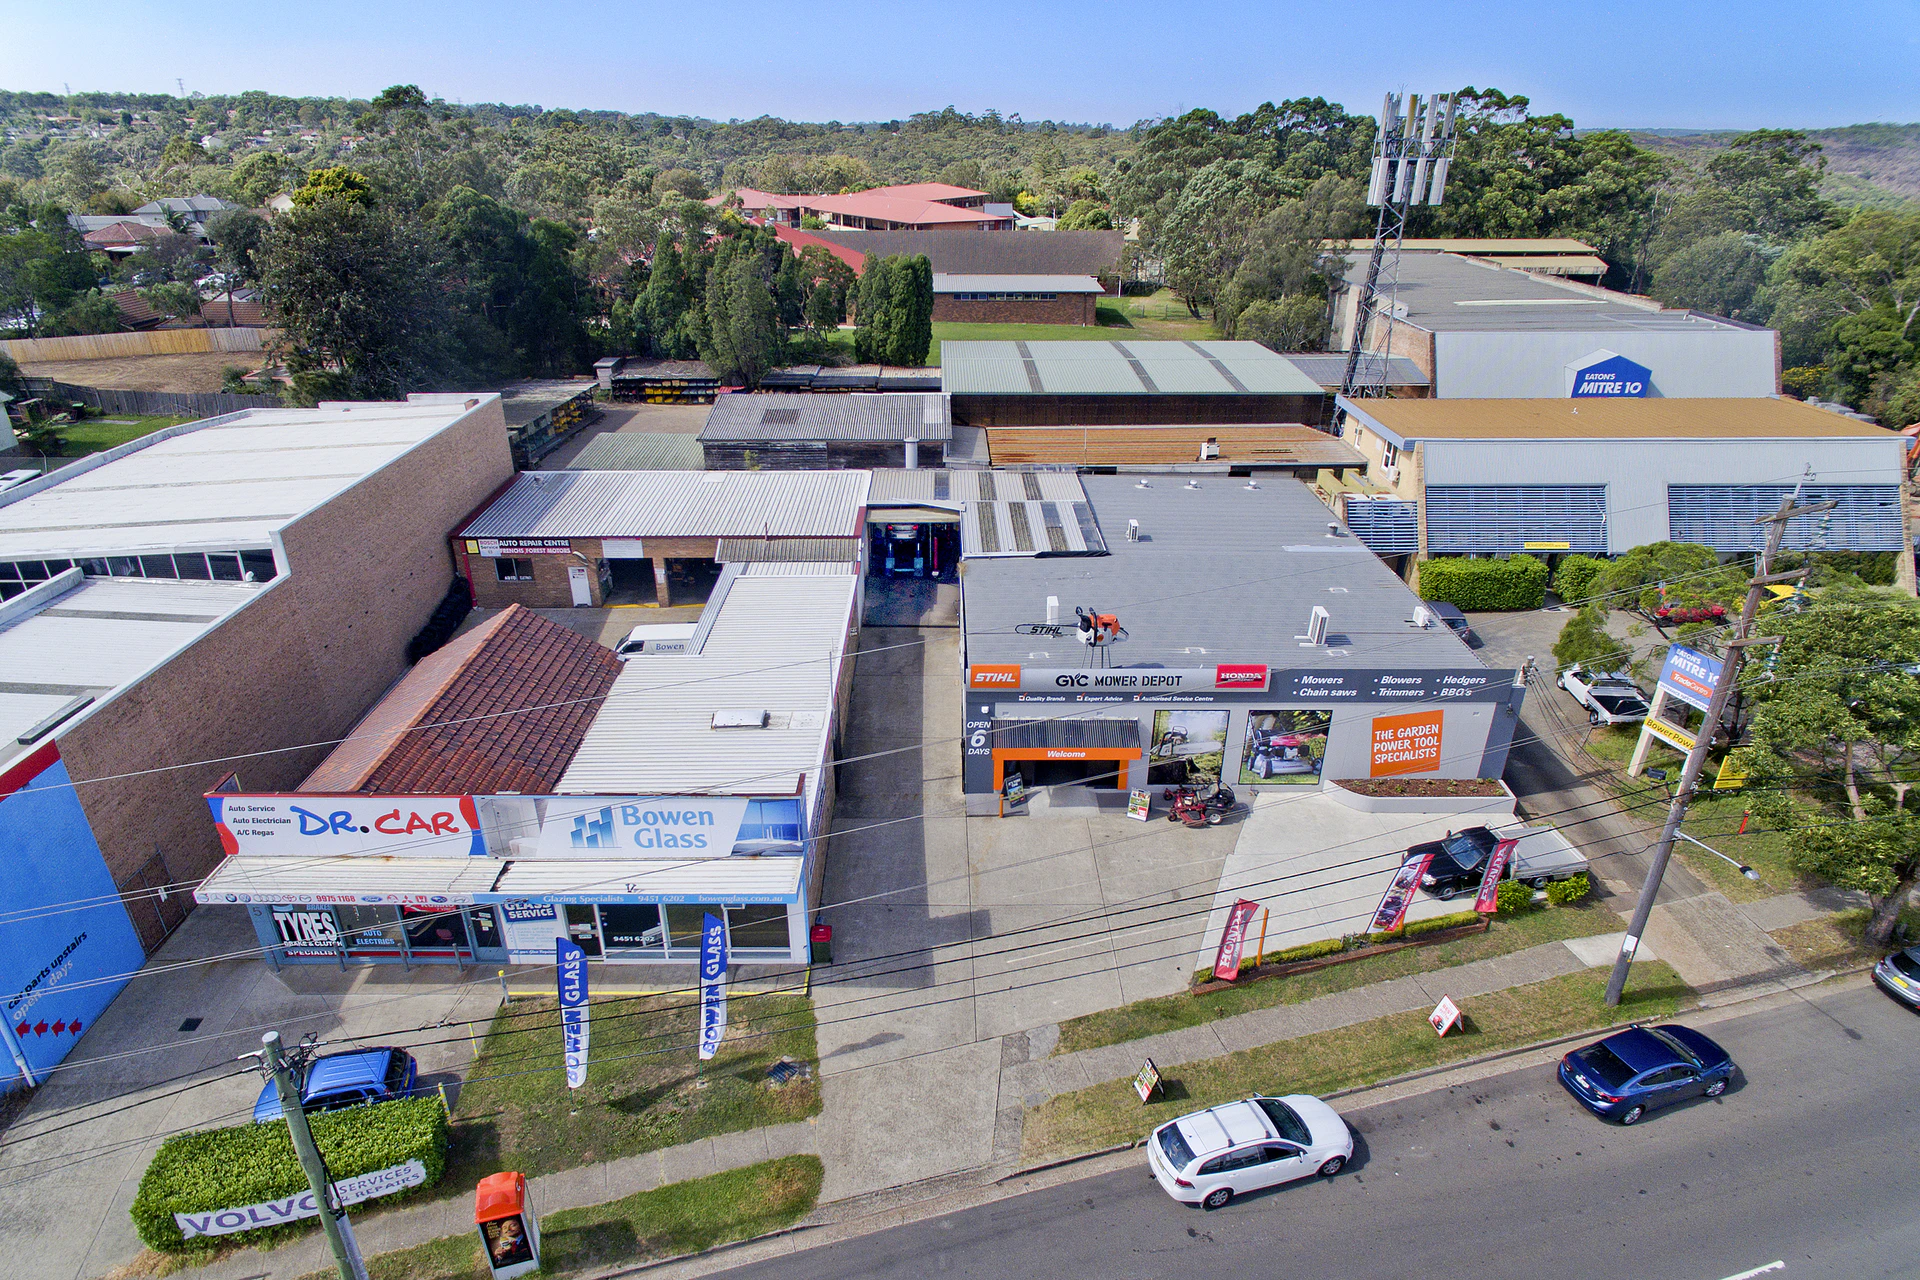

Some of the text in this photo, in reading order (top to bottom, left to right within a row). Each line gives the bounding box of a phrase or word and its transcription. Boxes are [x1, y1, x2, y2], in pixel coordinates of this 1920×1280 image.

[1578, 382, 1642, 394] MITRE 10
[1030, 626, 1062, 635] STIHL
[1676, 648, 1702, 664] EATON'S
[1670, 655, 1707, 679] MITRE
[974, 674, 1016, 682] STIHL
[1056, 673, 1182, 687] GYC MOWER DEPOT
[1301, 676, 1486, 686] Mowers Blowers Hedgers
[1674, 674, 1708, 696] TradeCentre
[1299, 688, 1328, 696] Chain
[1379, 688, 1424, 696] Trimmers
[971, 729, 987, 747] 6
[1374, 724, 1439, 740] THE GARDEN
[1646, 719, 1672, 738] Bower
[1672, 734, 1694, 750] Powe
[1374, 736, 1439, 752] POWER TOOL
[1374, 748, 1437, 764] SPECIALISTS
[621, 805, 714, 826] Bowen
[634, 828, 708, 848] Glass
[1481, 846, 1508, 901] HONDA
[544, 895, 576, 904] Glazing
[579, 895, 624, 903] Specialists
[698, 895, 783, 904] bowenglass.com.au
[510, 909, 554, 919] SERVICE
[273, 913, 337, 942] TYRES
[1220, 908, 1246, 968] HONDA
[25, 966, 50, 996] parts
[50, 931, 88, 969] upstairs
[13, 960, 73, 1020] open days
[703, 926, 722, 1054] BOWEN GLASS
[565, 950, 581, 1084] BOWEN GLASS
[339, 1166, 412, 1194] SERVICES
[355, 1173, 420, 1198] REPAIRS
